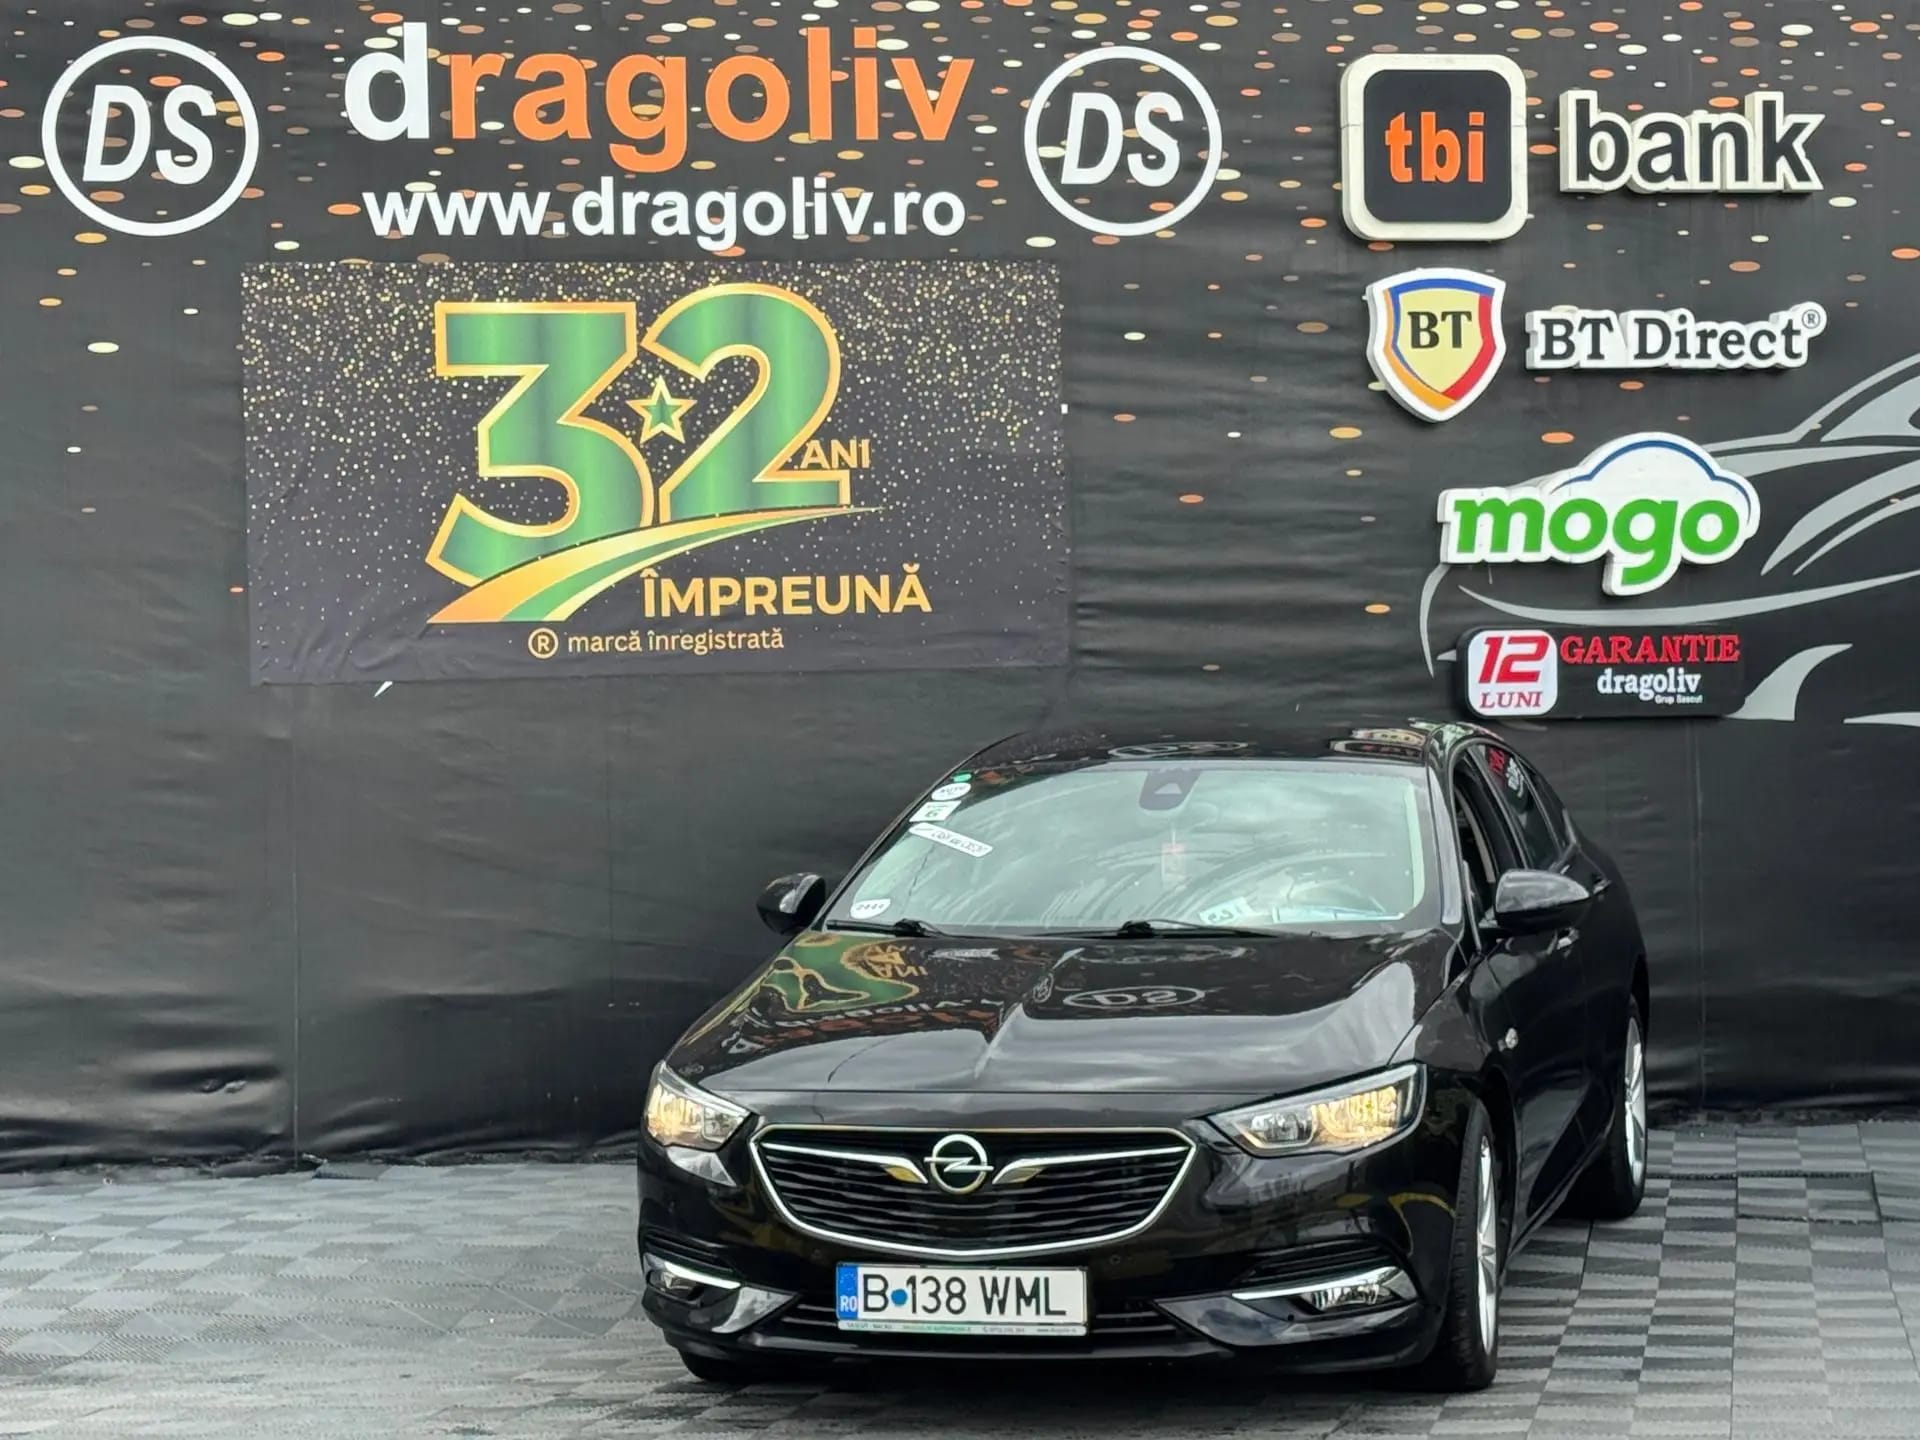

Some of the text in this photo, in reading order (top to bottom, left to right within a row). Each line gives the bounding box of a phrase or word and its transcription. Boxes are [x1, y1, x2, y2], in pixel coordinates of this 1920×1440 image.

[343, 22, 975, 172] dragoliv
[82, 84, 217, 184] DS
[1060, 91, 1184, 187] DS
[1385, 98, 1820, 185] tbi bank
[362, 176, 966, 252] www.dragoliv.ro
[1407, 310, 1473, 349] BT
[1540, 318, 1613, 360] BT
[424, 282, 850, 588] 32
[800, 439, 870, 469] ANI
[1454, 497, 1740, 586] mogo
[640, 563, 932, 618] ÎMPREUNĂ
[567, 629, 642, 653] marcă
[647, 627, 785, 655] înregistrată
[1478, 635, 1550, 684] 12
[1560, 634, 1741, 665] GARANTIE
[1479, 690, 1543, 709] LUNI
[1597, 667, 1702, 700] dragoliv
[839, 1295, 859, 1313] RO
[862, 1273, 1067, 1317] B 138 WML
